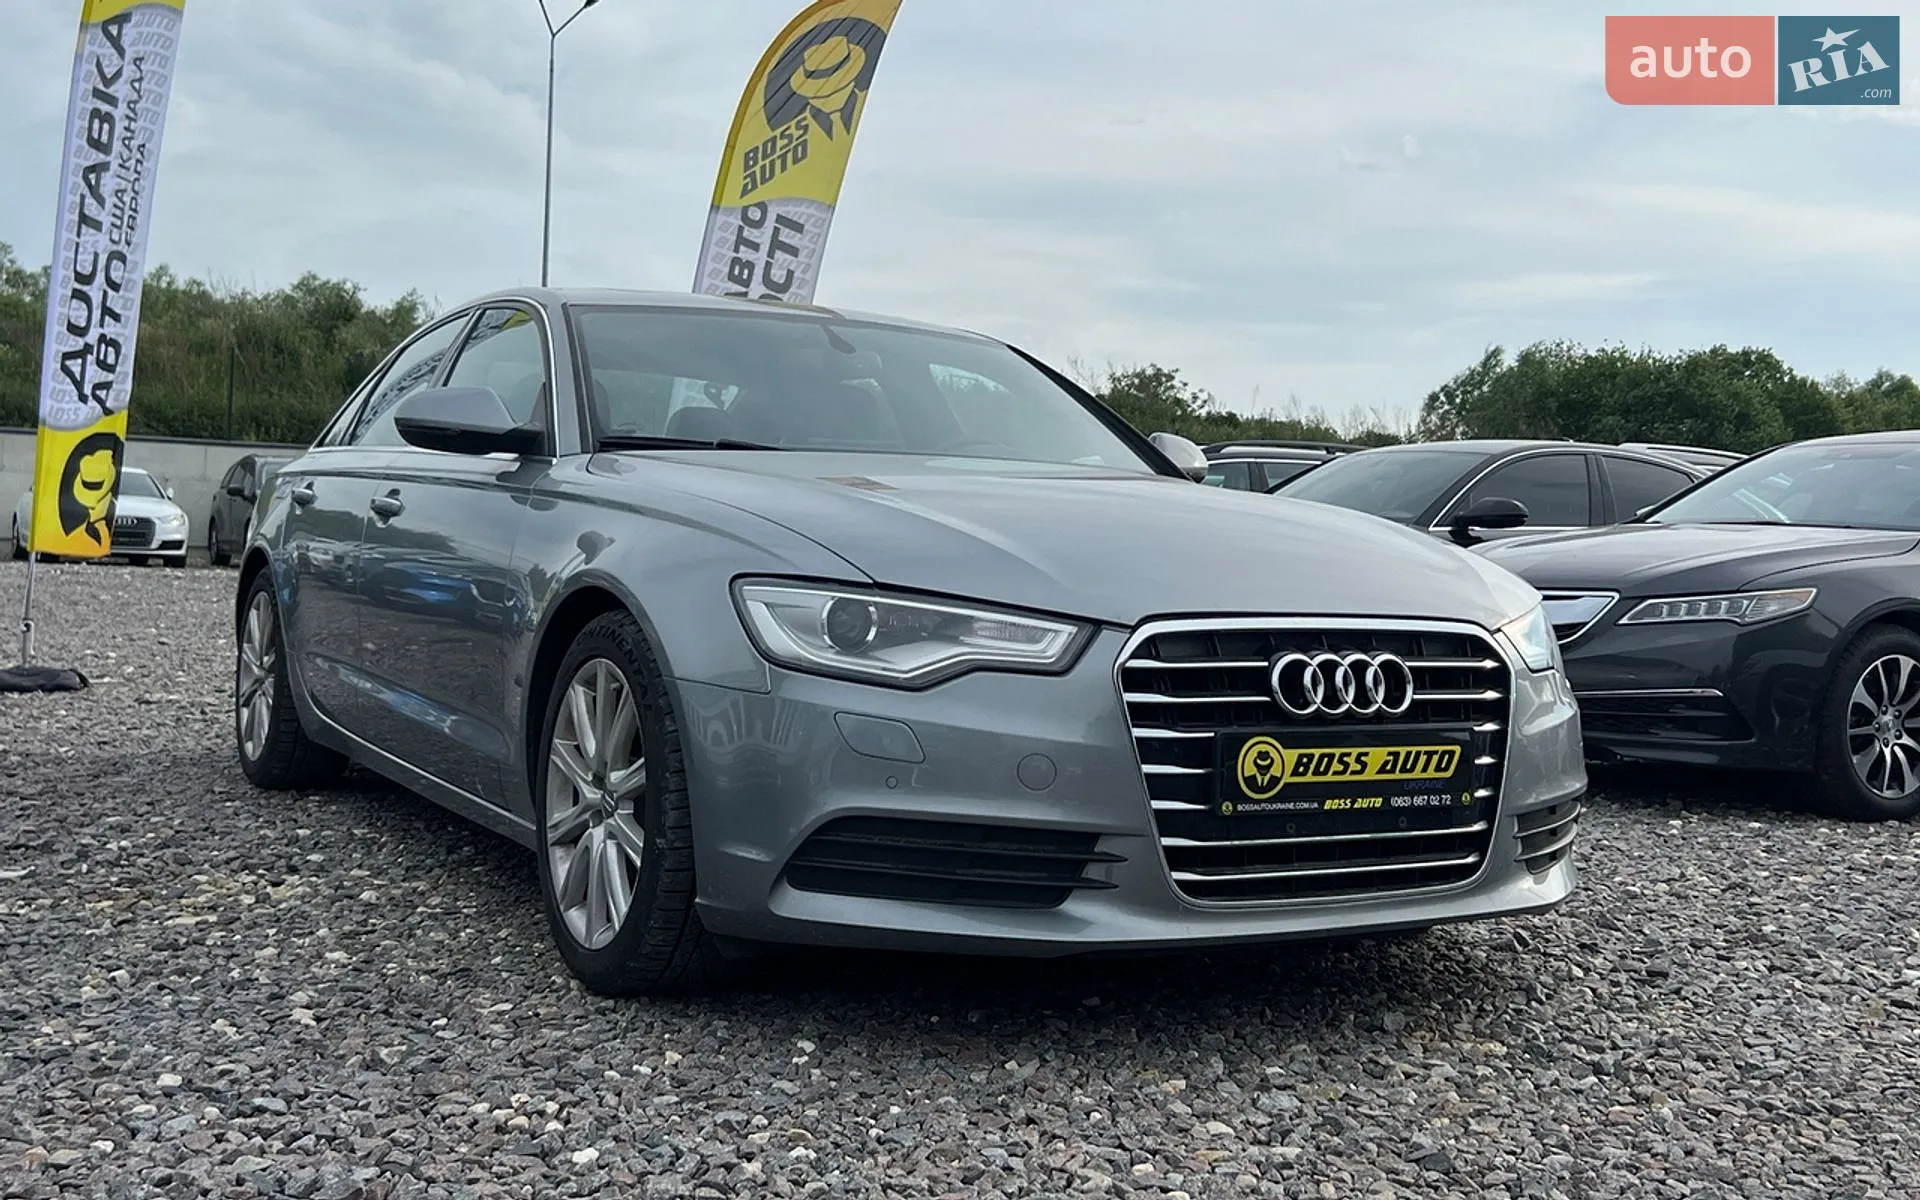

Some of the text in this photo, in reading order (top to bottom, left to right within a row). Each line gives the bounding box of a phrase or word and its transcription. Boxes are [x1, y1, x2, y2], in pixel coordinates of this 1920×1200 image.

[118, 56, 145, 172] КАНАДА
[743, 114, 809, 174] BOSS
[739, 137, 809, 199] AUTO
[60, 12, 132, 405] ДОСТАВКА
[91, 249, 127, 416] АВТО
[1289, 748, 1457, 778] BOSS AUTO
[1323, 797, 1383, 810] BOSS AUTO
[1441, 794, 1452, 805] 72
